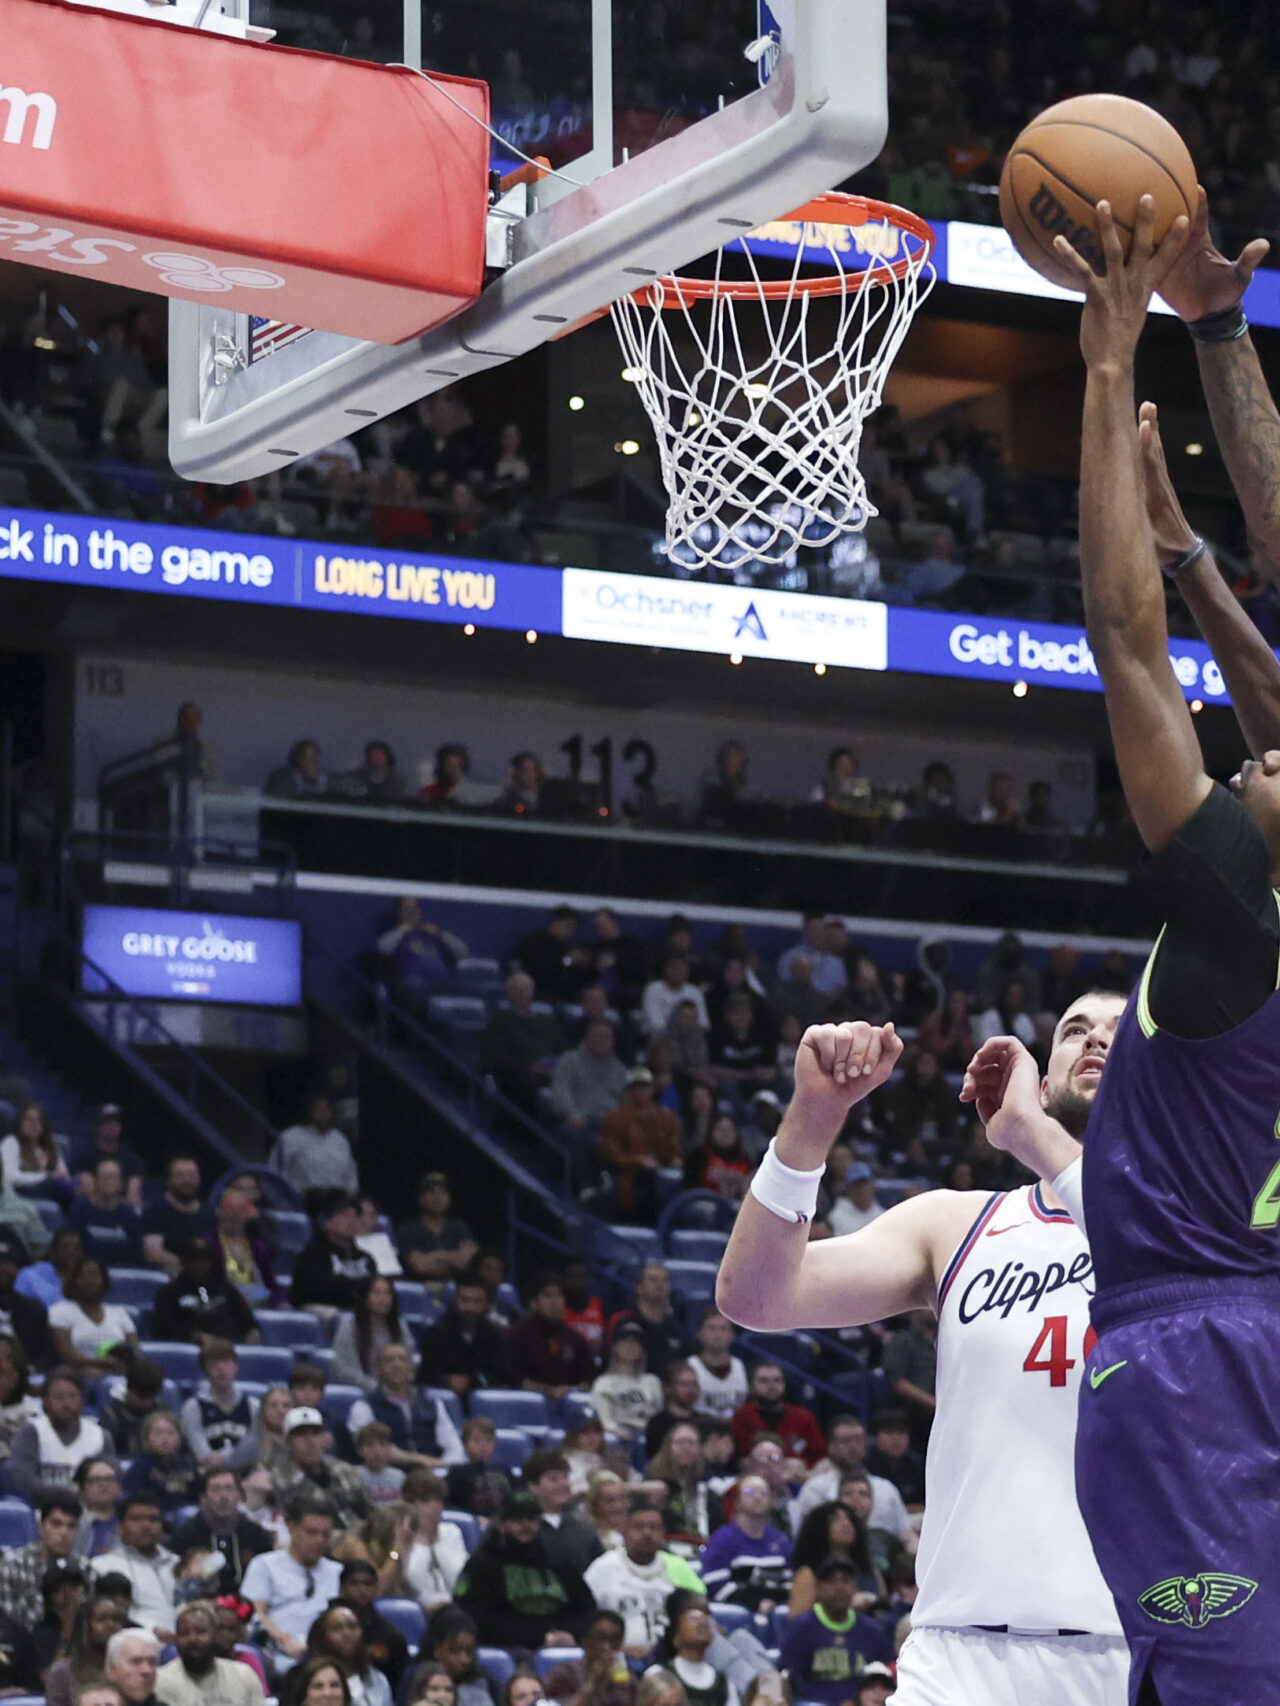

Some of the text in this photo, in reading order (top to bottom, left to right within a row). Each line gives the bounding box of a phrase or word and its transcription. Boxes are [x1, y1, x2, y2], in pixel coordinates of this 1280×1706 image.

[43, 523, 79, 566] in
[87, 529, 153, 574] the
[161, 545, 274, 587] game
[314, 555, 496, 611] LONG LIVE YOU
[595, 584, 714, 620] Ochsner
[949, 624, 1099, 677] Get back
[122, 931, 257, 964] GREY GOOSE
[959, 1252, 1096, 1325] Clippe
[1023, 1315, 1099, 1388] 4
